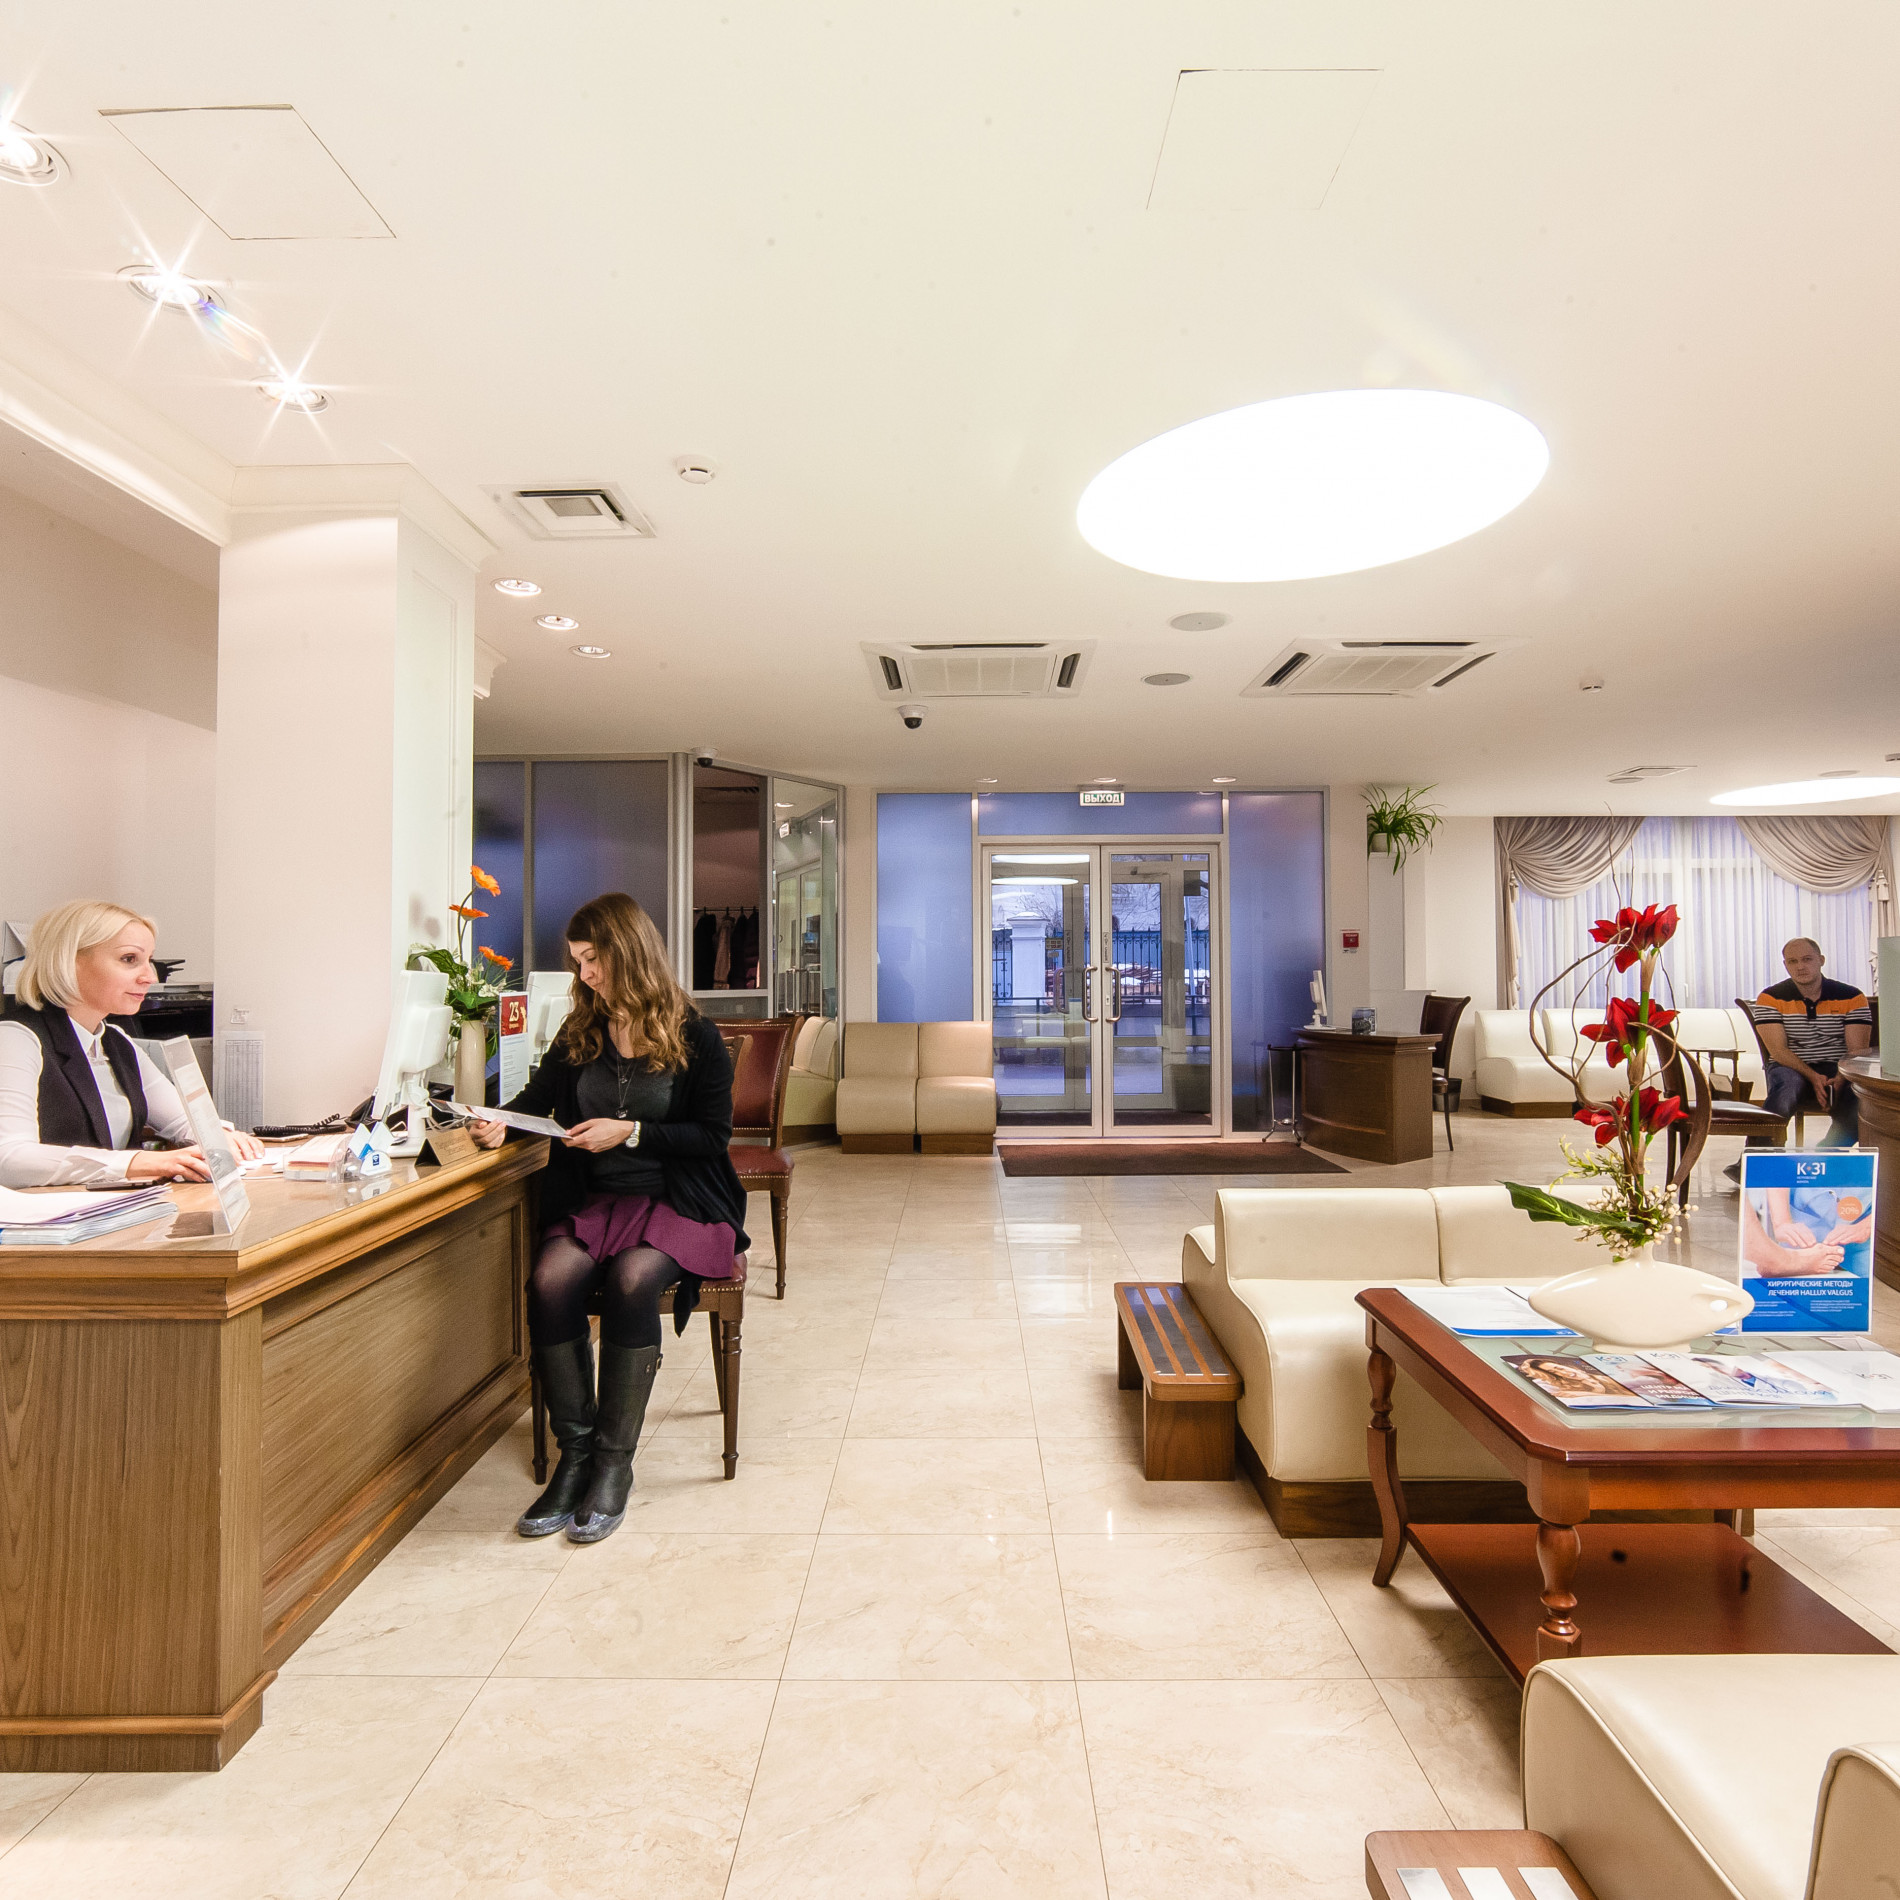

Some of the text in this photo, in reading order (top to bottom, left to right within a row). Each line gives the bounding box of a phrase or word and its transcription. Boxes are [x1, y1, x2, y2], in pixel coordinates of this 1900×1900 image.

[1084, 793, 1120, 803] ВЫХОД
[509, 1001, 519, 1022] 23
[1840, 1206, 1860, 1215] 20%
[1823, 1280, 1853, 1288] МЕТОДЫ
